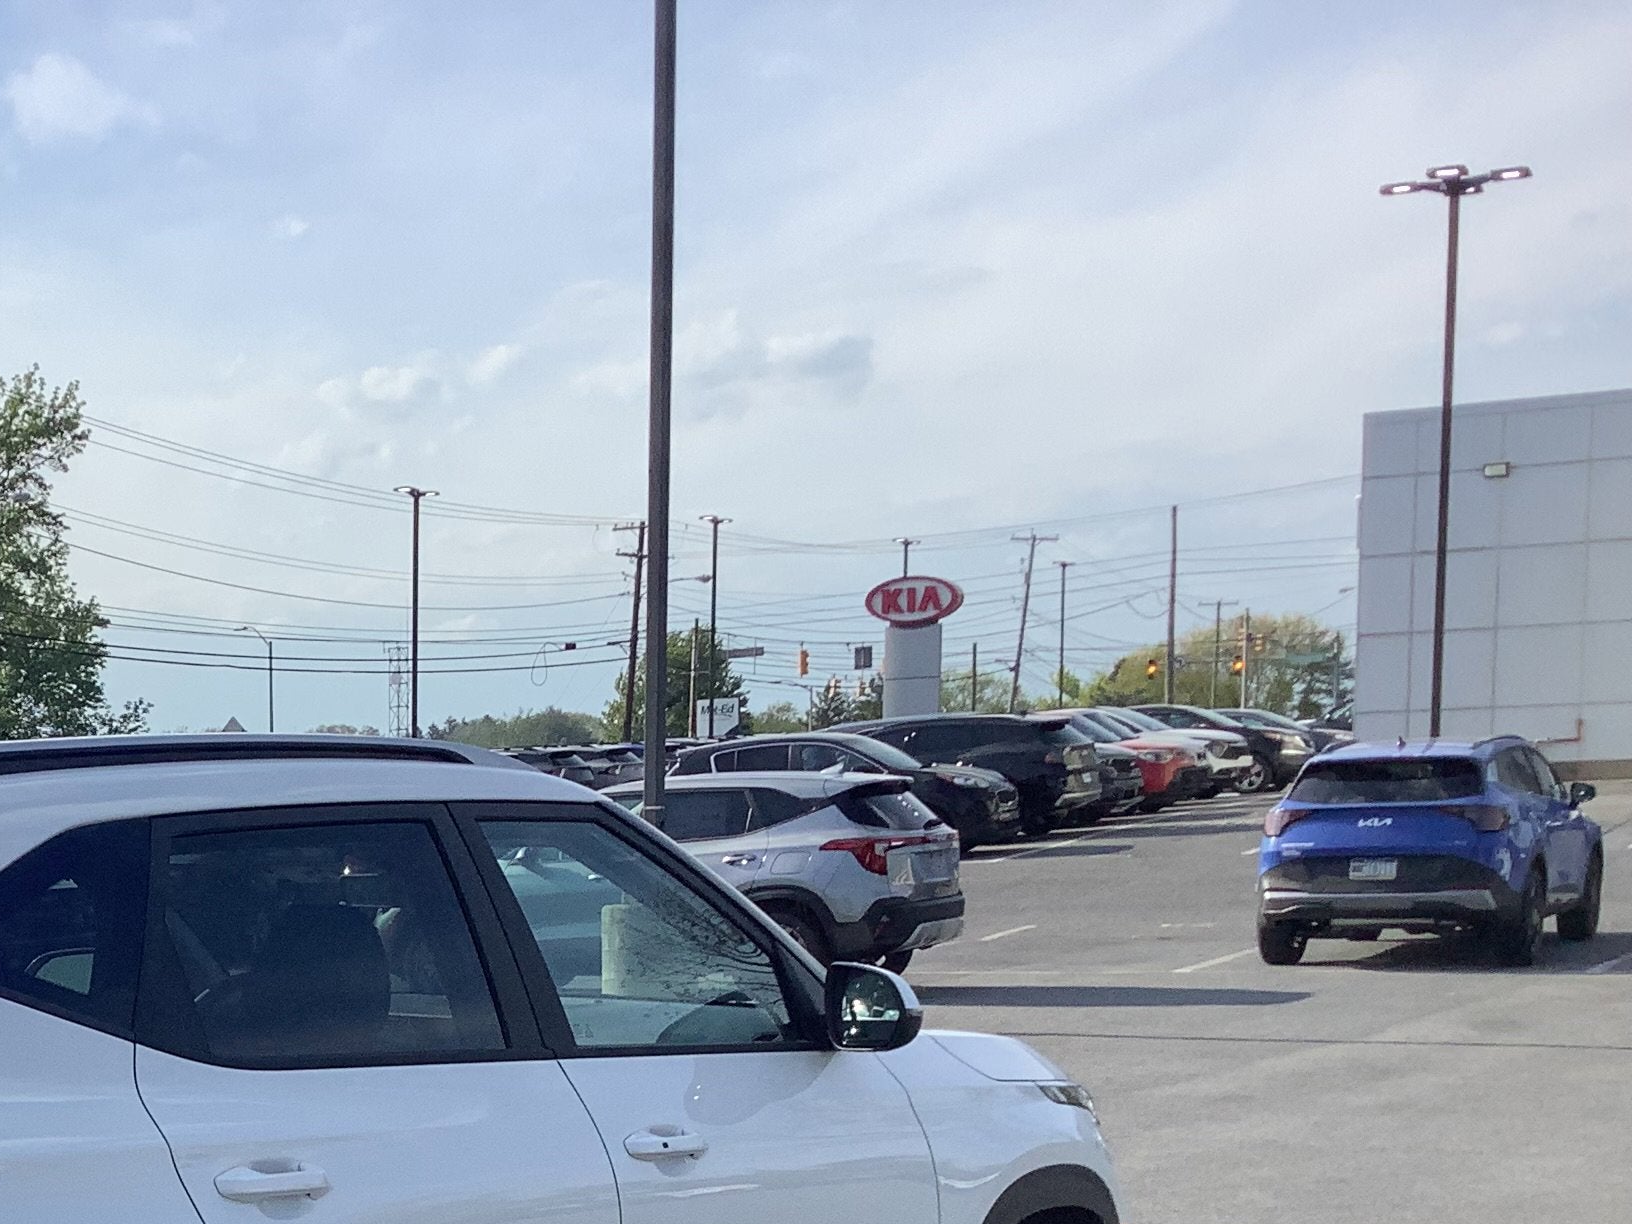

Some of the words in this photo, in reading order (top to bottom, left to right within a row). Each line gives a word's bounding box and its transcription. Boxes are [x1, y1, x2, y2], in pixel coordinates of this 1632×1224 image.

[880, 586, 943, 615] KIA
[700, 703, 735, 715] Mt-Ed
[1357, 817, 1393, 828] KIA
